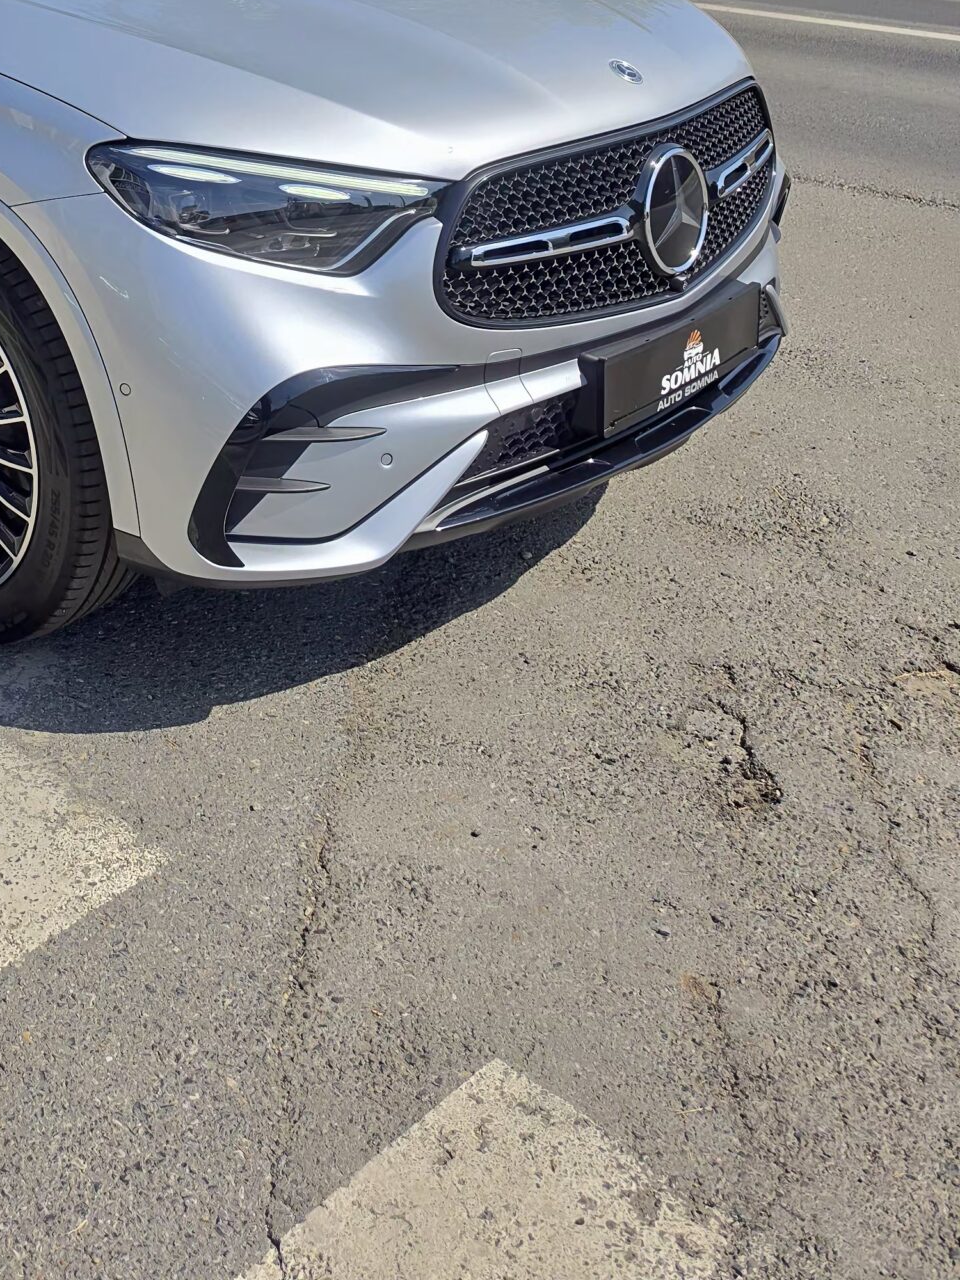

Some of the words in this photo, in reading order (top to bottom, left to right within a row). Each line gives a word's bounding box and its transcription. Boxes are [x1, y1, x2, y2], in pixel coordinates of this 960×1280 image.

[660, 347, 721, 396] SOMNIA
[683, 353, 703, 369] AUTO
[656, 389, 683, 413] AUTO
[684, 369, 719, 397] SOMNIA
